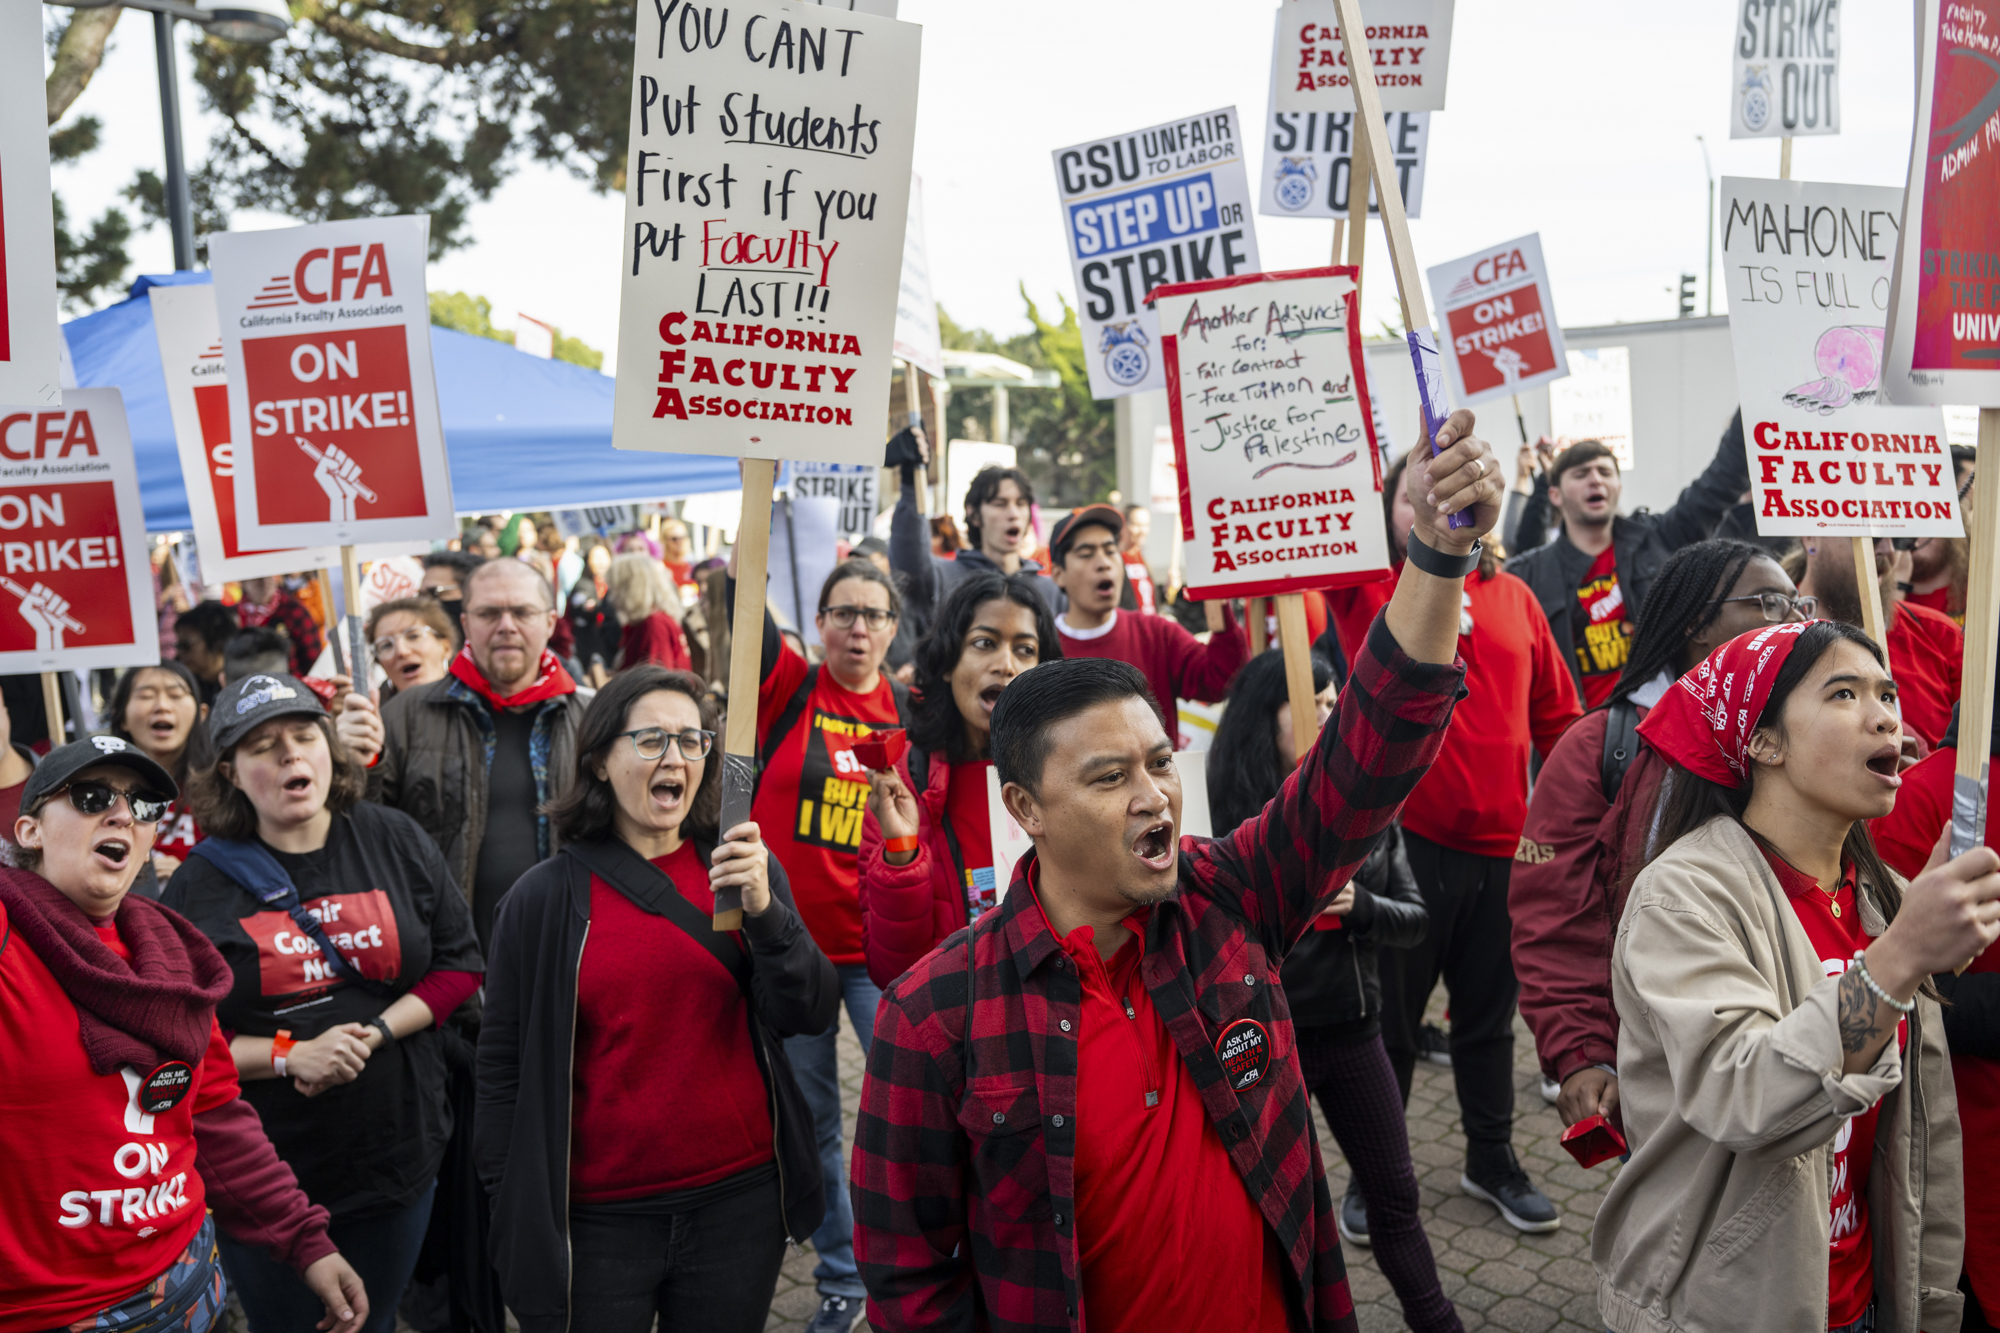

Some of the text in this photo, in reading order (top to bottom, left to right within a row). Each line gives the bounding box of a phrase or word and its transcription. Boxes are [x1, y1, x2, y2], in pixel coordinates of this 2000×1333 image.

[655, 0, 728, 59] YOU
[1299, 23, 1429, 44] CALORNIA
[1740, 0, 1836, 59] STRIKE
[1299, 47, 1426, 68] FACLTY
[1296, 71, 1423, 92] ASSOTION
[1782, 62, 1835, 130] OUT
[640, 75, 881, 156] Put Students
[1273, 112, 1419, 154] STRE
[1060, 114, 1232, 194] CSU UNFAIR
[1146, 142, 1235, 176] TO LABOR
[637, 150, 878, 240] First if you
[1327, 157, 1418, 213] OT
[1075, 180, 1244, 255] STEP UP OR
[699, 218, 840, 287] Faculty
[1472, 247, 1528, 287] CFA
[294, 243, 393, 304] CFA
[1081, 230, 1247, 322] STRIKE
[1739, 265, 1783, 304] IS
[1795, 271, 1860, 309] FULL
[696, 273, 830, 323] LAST!!!
[1473, 295, 1514, 325] ON
[1949, 282, 1985, 308] THE
[240, 303, 404, 329] California Faculty Association
[1180, 299, 1346, 343] Another Adjunct
[659, 310, 862, 357] CALIFORNIA
[1455, 311, 1545, 356] STRIKE!
[290, 340, 359, 383] ON
[658, 349, 857, 394] FACULTY
[1197, 362, 1226, 380] Fair
[652, 387, 853, 426] ASSOCIATION
[1199, 386, 1238, 406] Free
[254, 390, 411, 437] STRIKE!
[0, 410, 100, 461] CFA
[1201, 411, 1281, 451] Justice
[1244, 422, 1361, 463] Palestine
[1753, 421, 1942, 454] CALIFORNIA
[41, 461, 110, 476] Association
[1758, 455, 1942, 487] FACULTY
[796, 476, 872, 503] STRIKE
[1207, 488, 1356, 521] CALIFORNIA
[1762, 489, 1952, 520] ASSOCIATION
[839, 506, 872, 534] UT
[1211, 512, 1354, 547] FACULTY
[0, 536, 120, 574] RIKE!
[1212, 541, 1358, 573] ASSOCIATION
[1585, 620, 1620, 646] BUT
[1723, 672, 1734, 692] CFA
[1737, 709, 1748, 729] CFA
[823, 777, 872, 809] BUT
[799, 799, 814, 836] I
[302, 900, 342, 924] air
[274, 924, 383, 955] Conact
[1222, 1034, 1262, 1060] ABOUT MY
[1226, 1028, 1255, 1049] ASK ME
[1225, 1045, 1263, 1068] HEALTH &
[1231, 1055, 1259, 1075] SAFETY
[150, 1076, 189, 1087] ABOUT MY
[158, 1069, 186, 1080] ASK ME
[1244, 1068, 1259, 1081] CFA
[114, 1142, 169, 1179] ON
[58, 1172, 190, 1228] STRIKE
